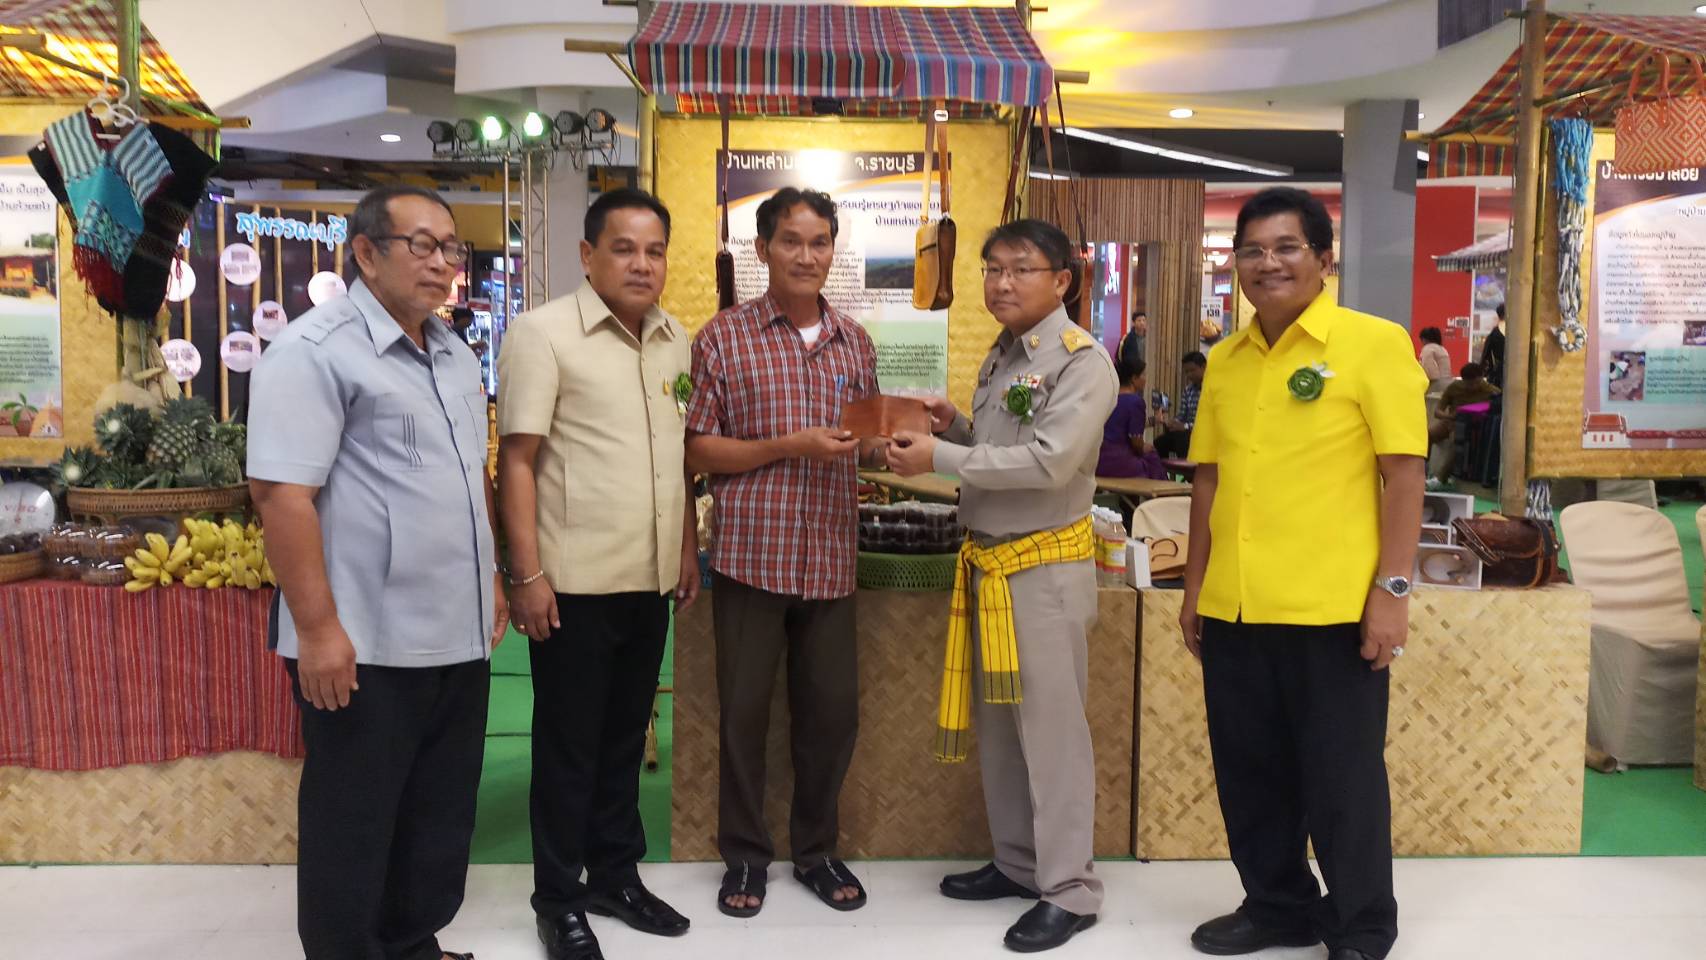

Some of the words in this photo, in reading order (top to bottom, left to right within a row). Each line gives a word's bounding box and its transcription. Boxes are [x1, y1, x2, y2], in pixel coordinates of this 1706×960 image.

[855, 154, 916, 176] จ.ราชบุรี
[235, 212, 348, 252] สุพรรณบุรี
